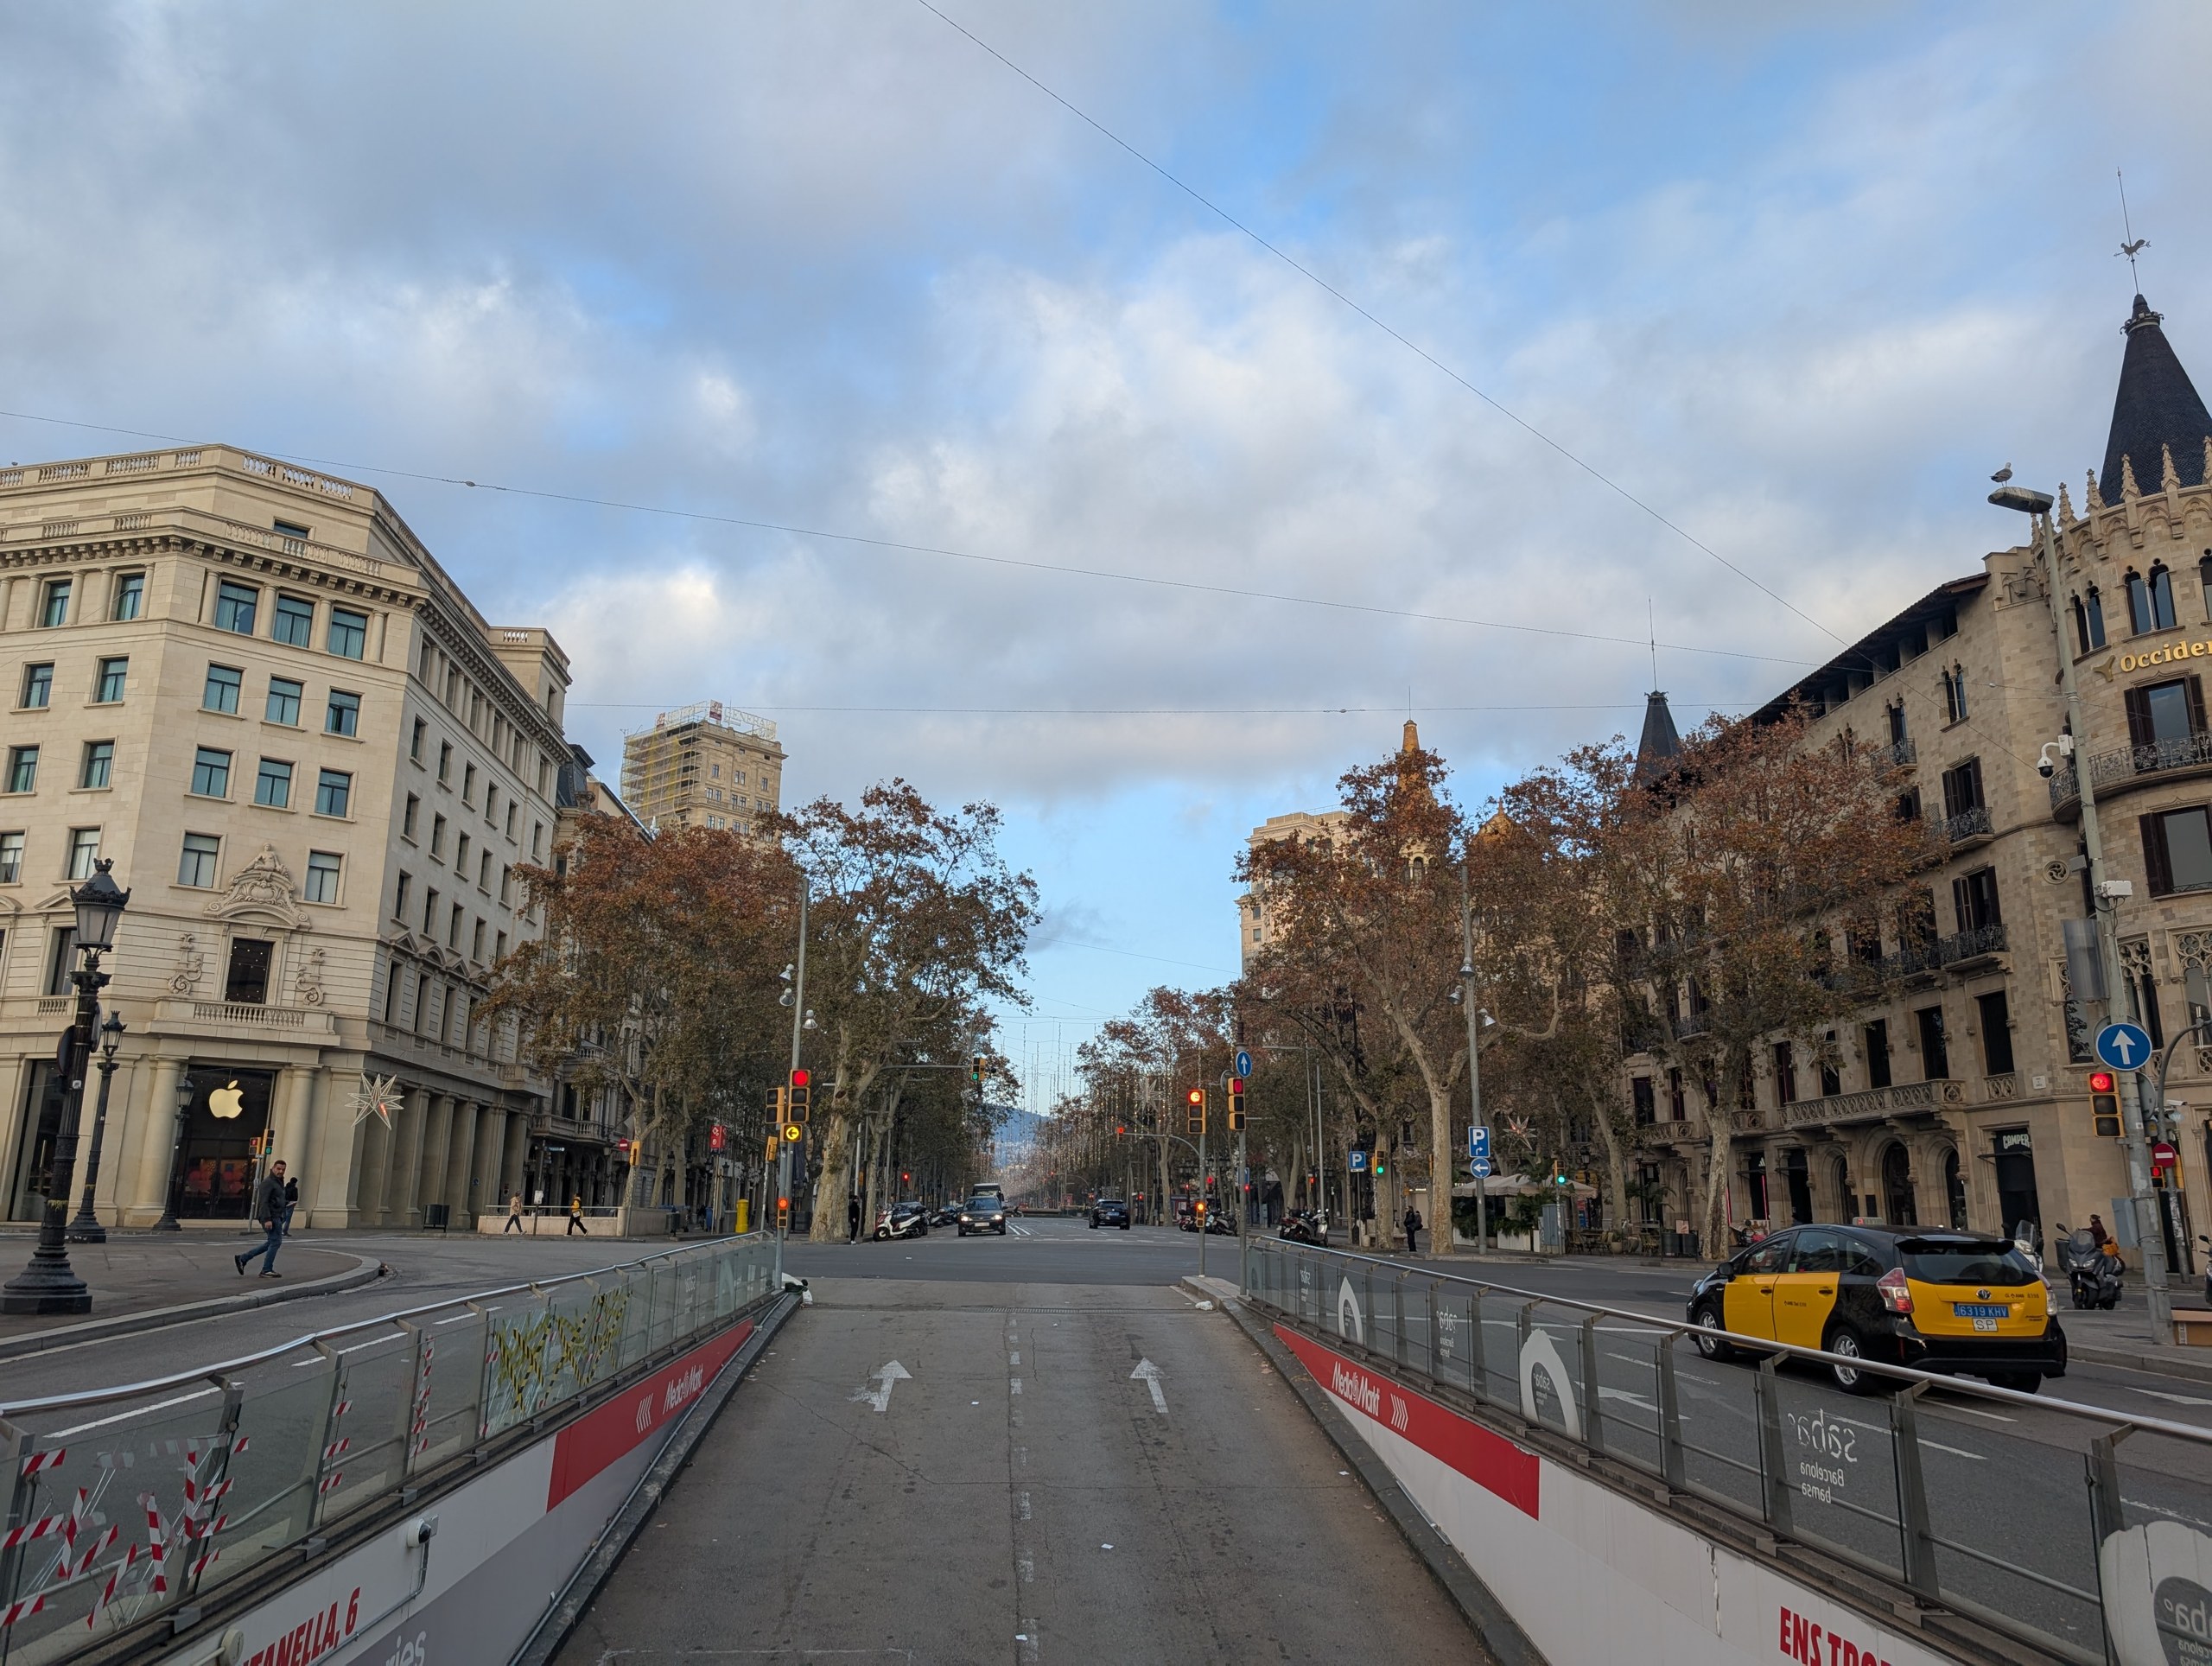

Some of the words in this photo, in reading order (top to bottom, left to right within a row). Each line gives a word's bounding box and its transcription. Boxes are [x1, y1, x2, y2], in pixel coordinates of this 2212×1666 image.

[1473, 1129, 1484, 1145] P
[2003, 1134, 2031, 1148] CAMPER
[1352, 1154, 1362, 1167] P
[1960, 1306, 1986, 1317] 6319
[1988, 1306, 2007, 1317] KHV
[1975, 1319, 1993, 1330] SP
[244, 1601, 341, 1666] ANELLA,
[346, 1587, 361, 1636] 6
[1780, 1606, 1822, 1666] ENS
[386, 1631, 427, 1666] ies
